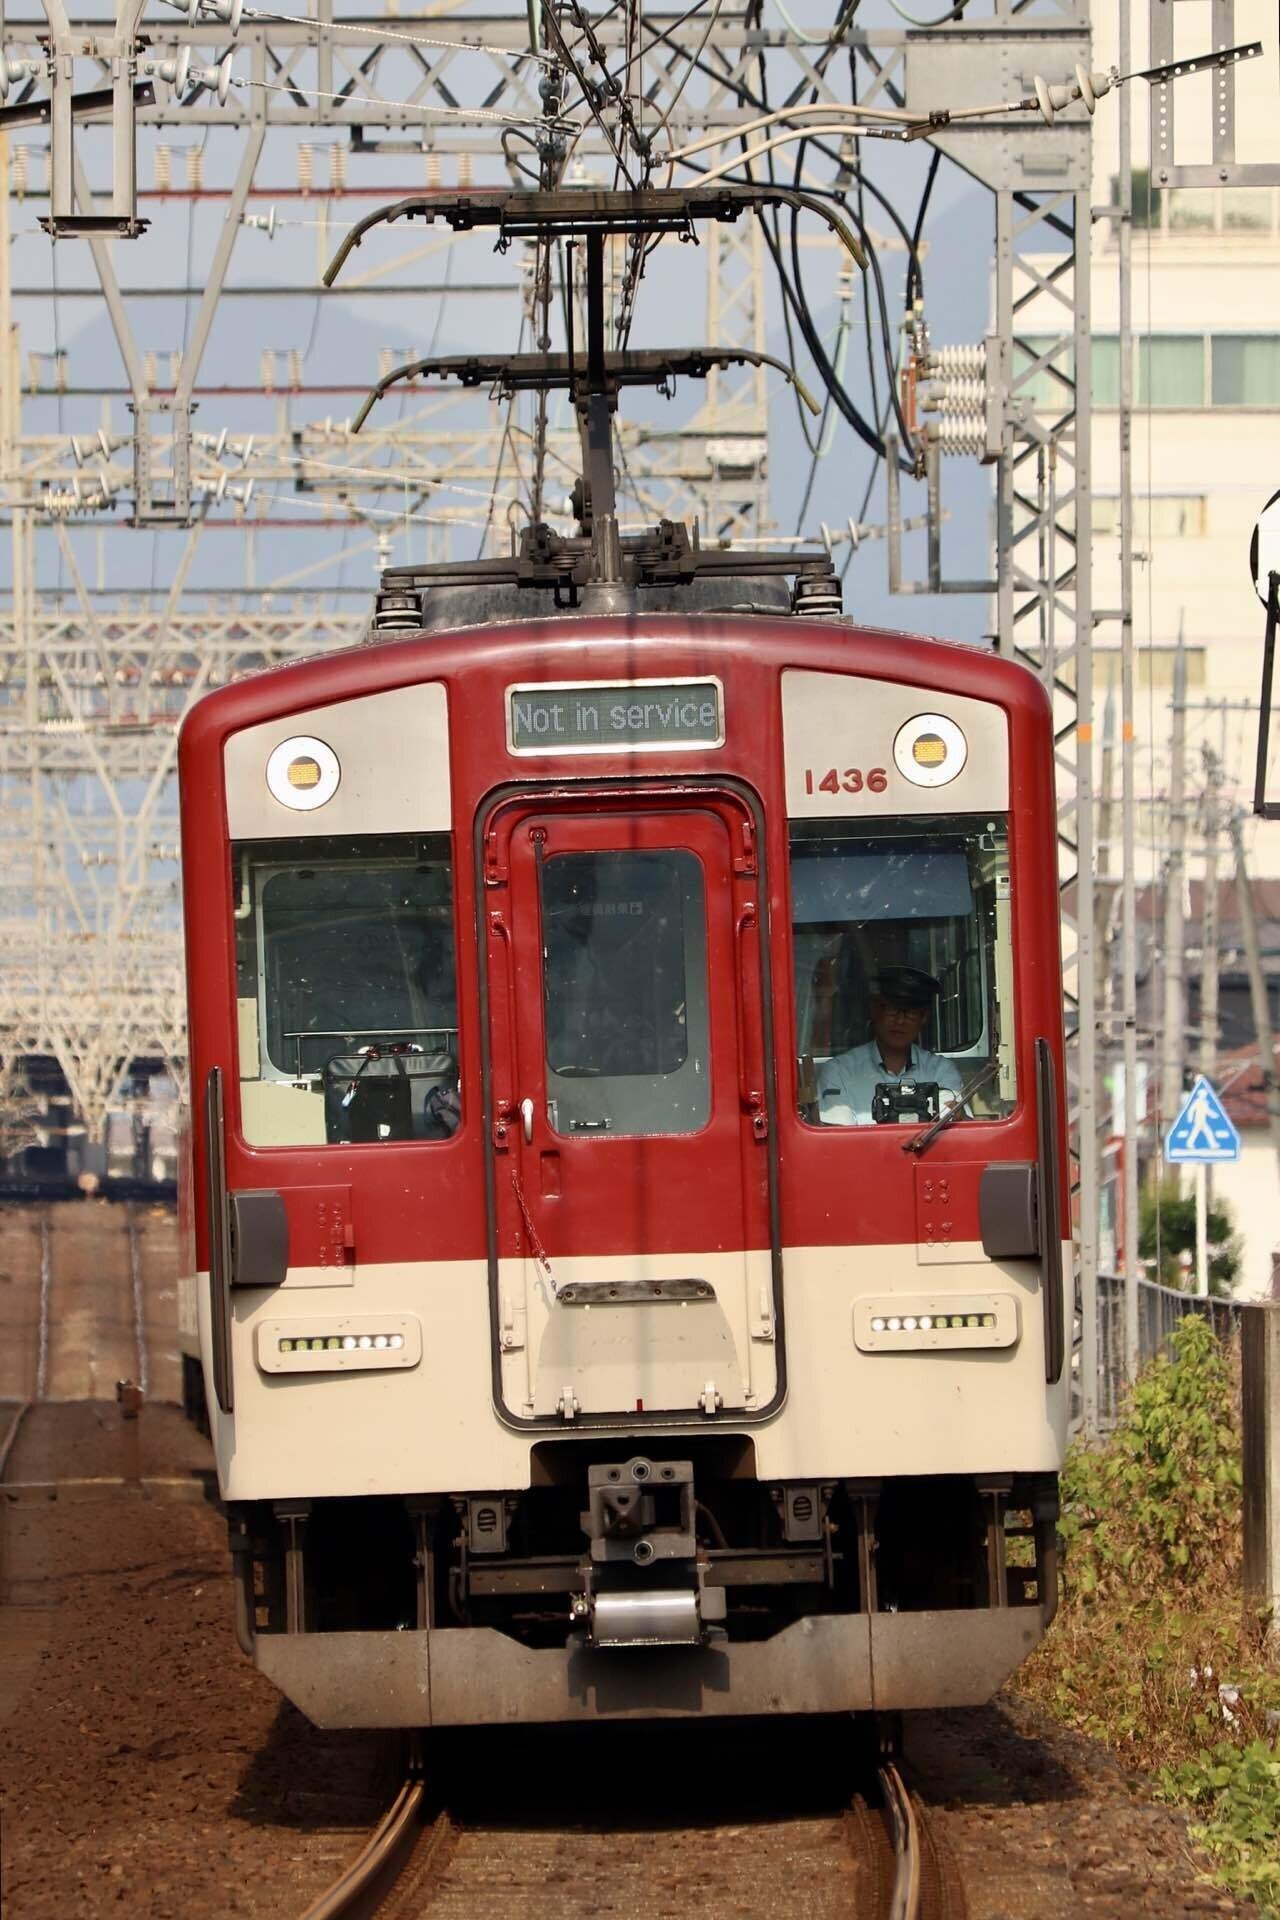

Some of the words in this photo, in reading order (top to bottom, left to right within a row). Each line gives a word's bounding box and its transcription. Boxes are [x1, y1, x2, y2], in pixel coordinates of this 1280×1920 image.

[514, 703, 565, 733] Not
[576, 702, 599, 731] in
[610, 698, 716, 729] service
[805, 767, 888, 795] 1436
